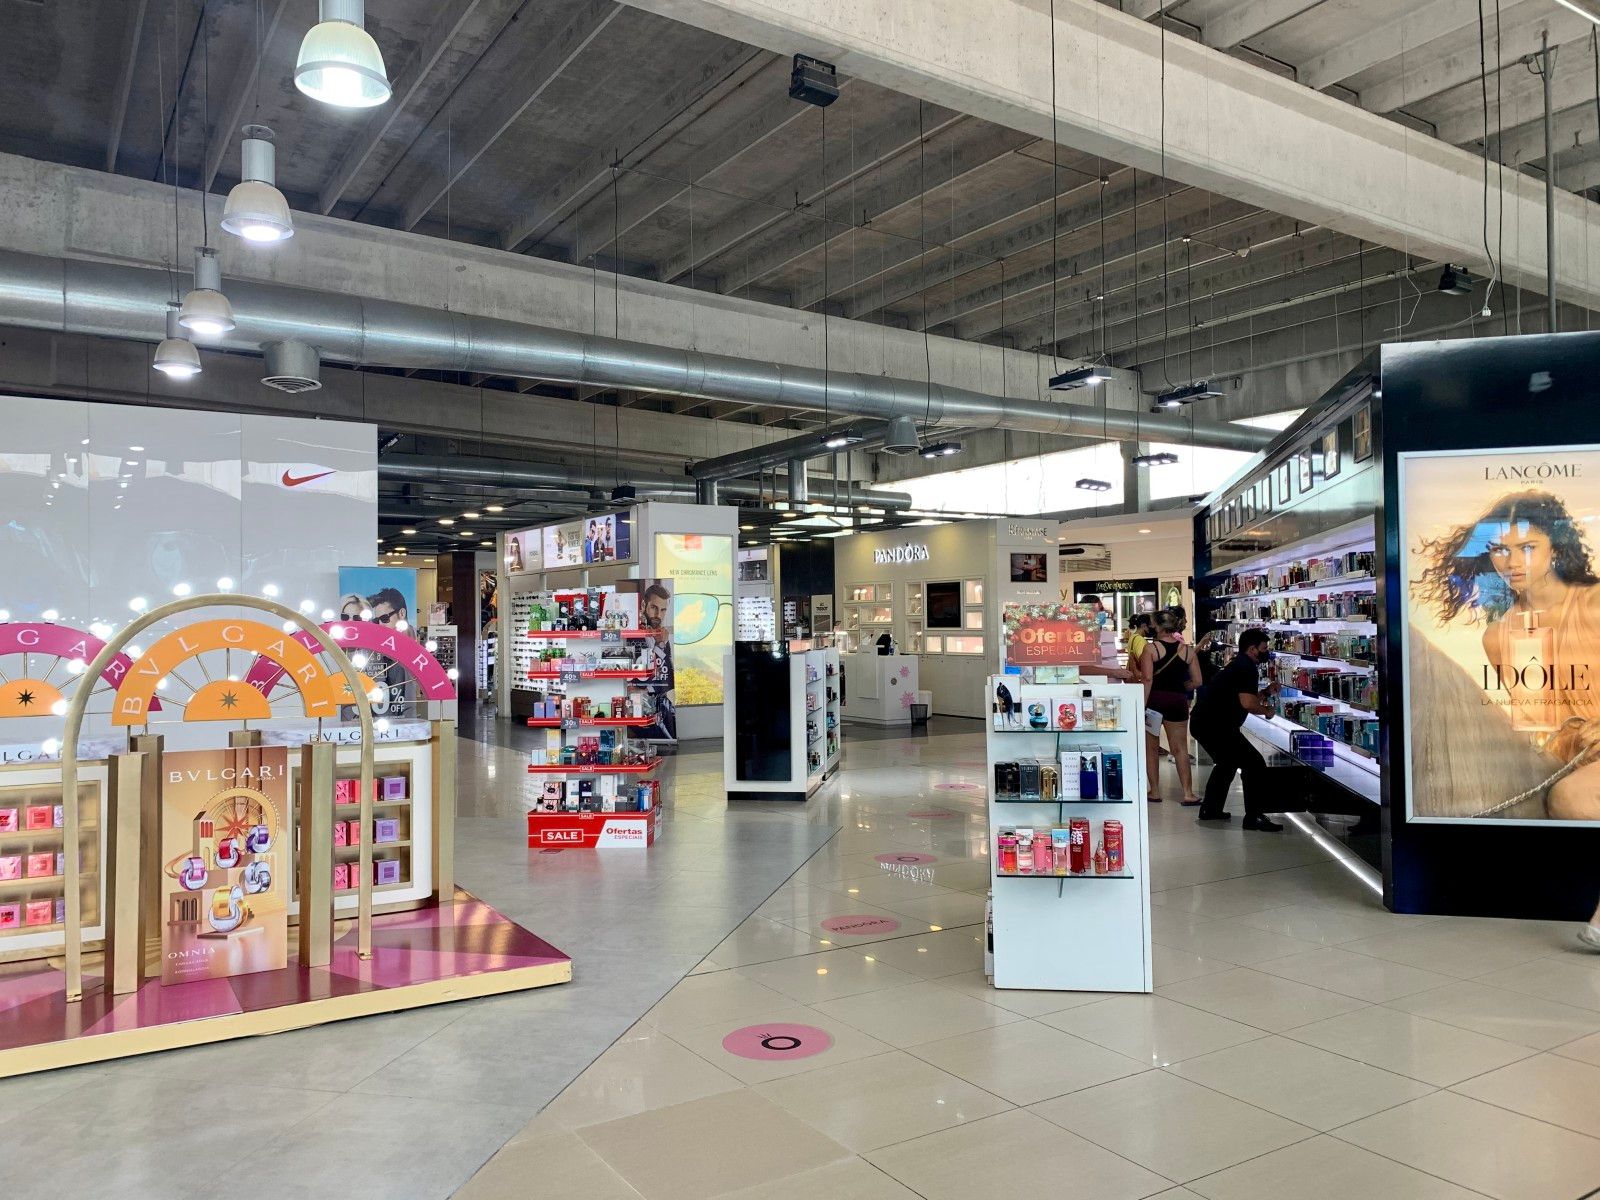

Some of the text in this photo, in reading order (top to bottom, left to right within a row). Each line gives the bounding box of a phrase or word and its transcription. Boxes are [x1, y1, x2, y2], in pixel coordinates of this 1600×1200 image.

[1484, 461, 1583, 480] LANCÔME
[873, 544, 930, 564] PANDORA
[1020, 627, 1086, 644] Oferta
[1026, 645, 1083, 656] ESPECIAL
[121, 625, 329, 715] BVLGARI
[390, 704, 405, 712] OFF
[168, 764, 284, 783] BVLGARI
[546, 827, 643, 840] SALE Ofertas
[167, 947, 216, 959] OMNIA
